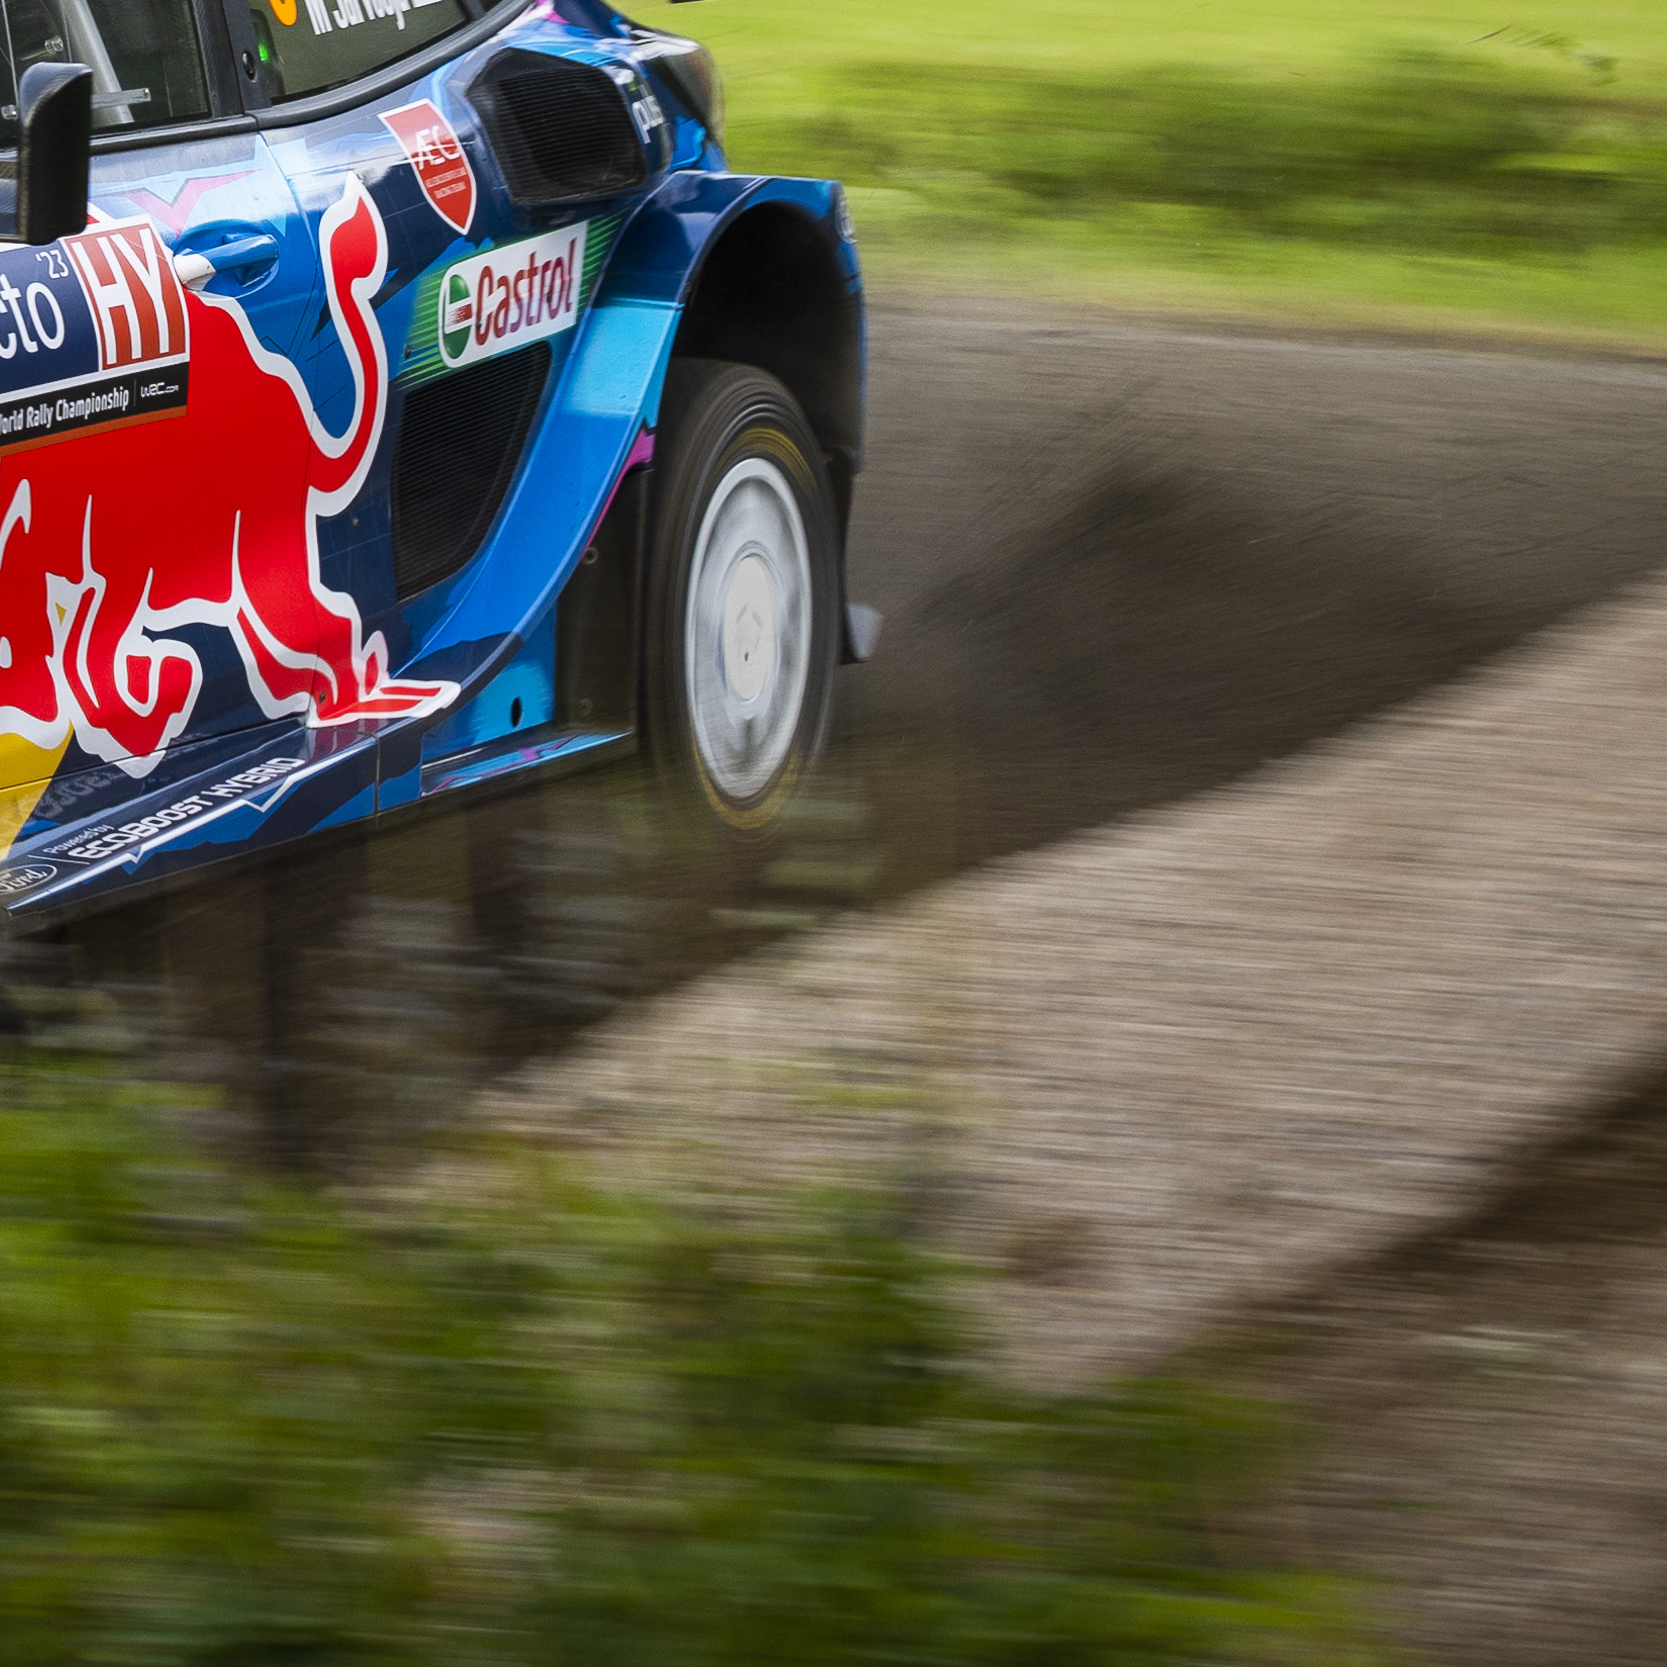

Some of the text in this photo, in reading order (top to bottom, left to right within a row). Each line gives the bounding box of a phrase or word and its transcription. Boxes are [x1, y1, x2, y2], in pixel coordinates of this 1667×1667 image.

[71, 227, 170, 366] HY
[473, 237, 578, 347] Castrol
[26, 405, 54, 429] Rally
[55, 386, 130, 421] Championship
[42, 829, 99, 854] Powered
[67, 756, 307, 860] ECOBOOST HYBRID
